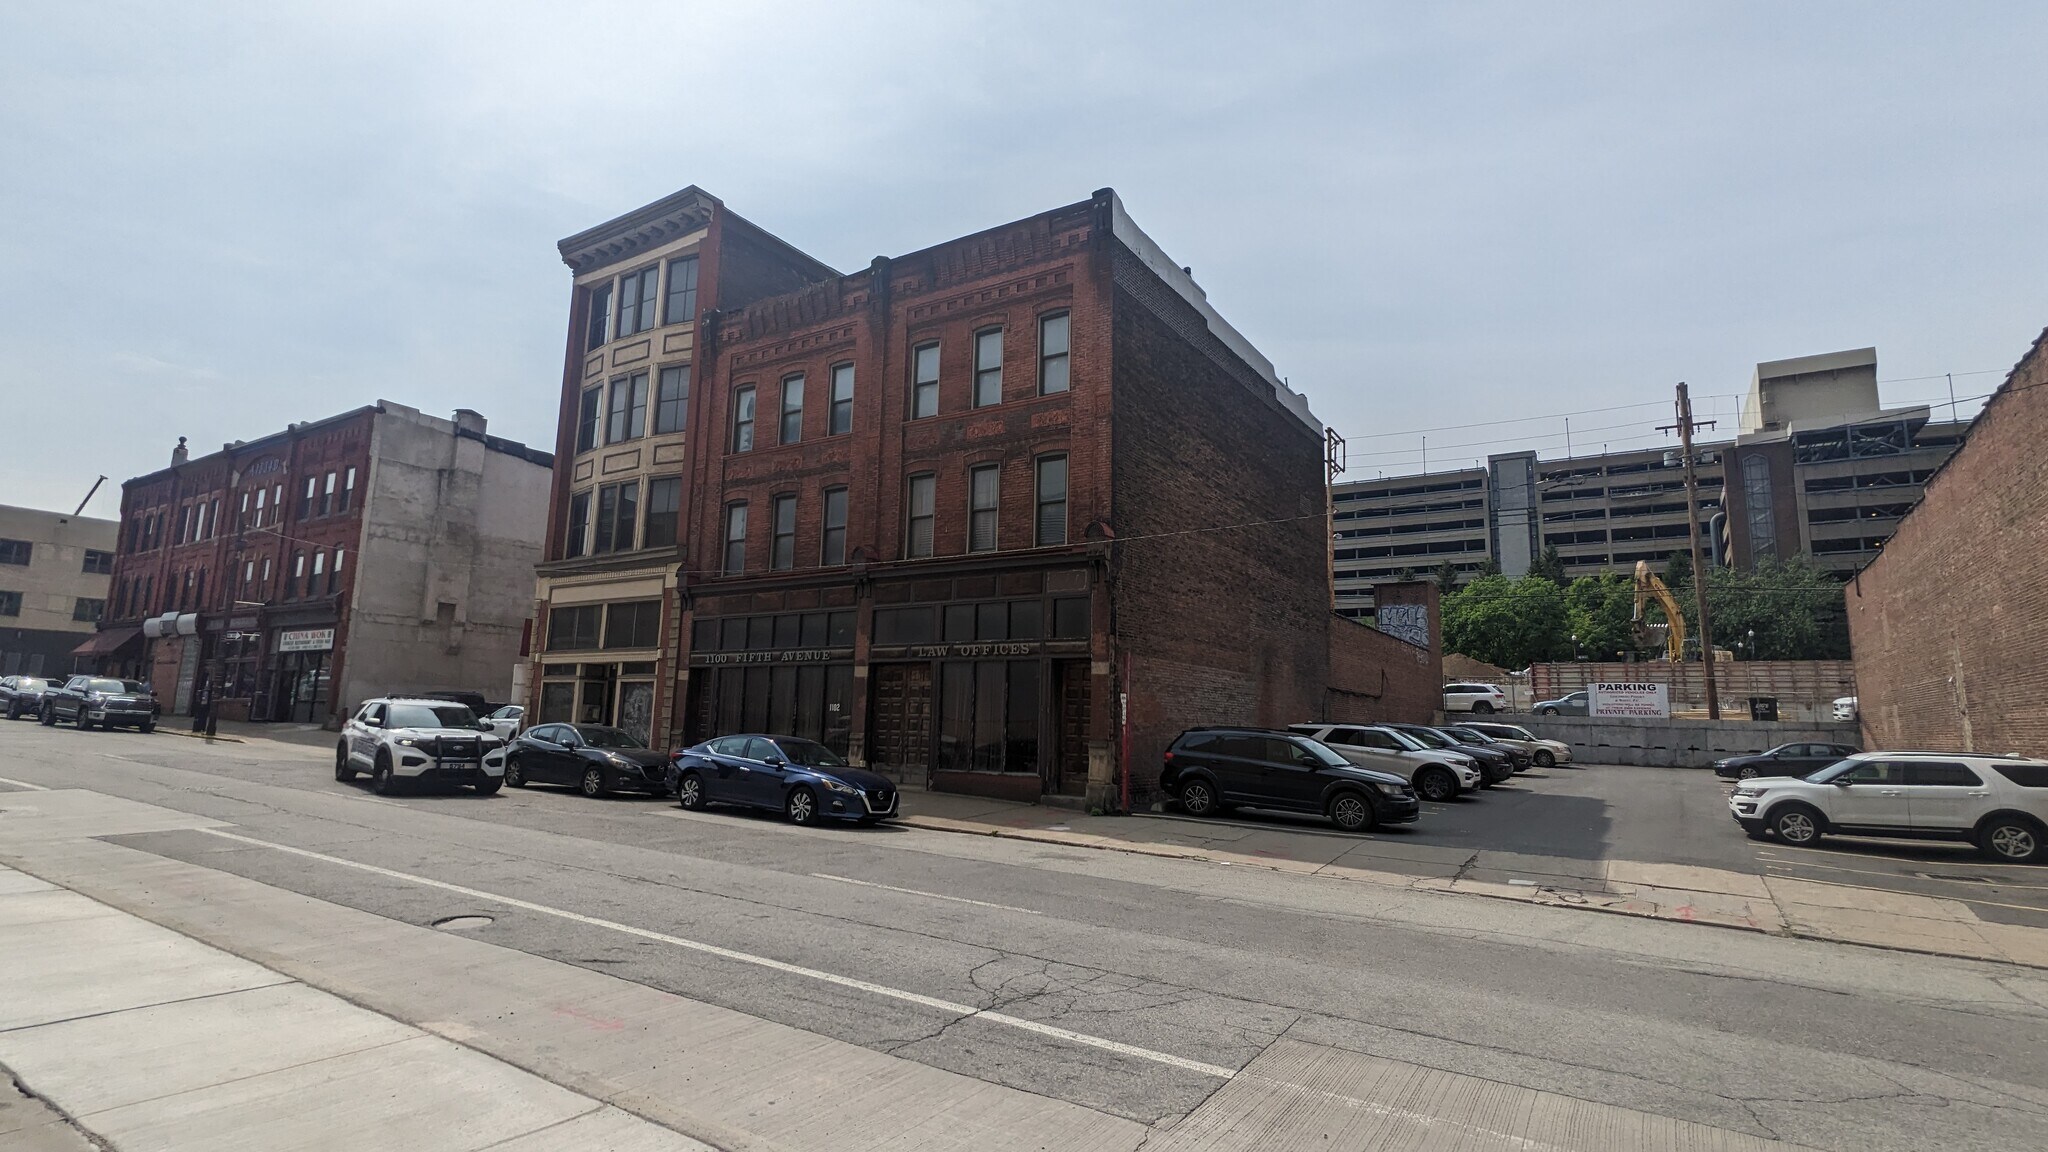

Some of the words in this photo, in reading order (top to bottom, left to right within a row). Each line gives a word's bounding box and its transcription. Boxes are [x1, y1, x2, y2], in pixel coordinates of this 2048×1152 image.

[289, 631, 309, 640] CHINA
[311, 630, 326, 639] WOK
[918, 645, 949, 657] LAW
[960, 643, 1030, 656] OFFICES
[705, 653, 727, 664] 1100
[735, 652, 772, 663] FIFTH
[781, 650, 831, 661] AVENUE
[1598, 683, 1657, 691] PARKING
